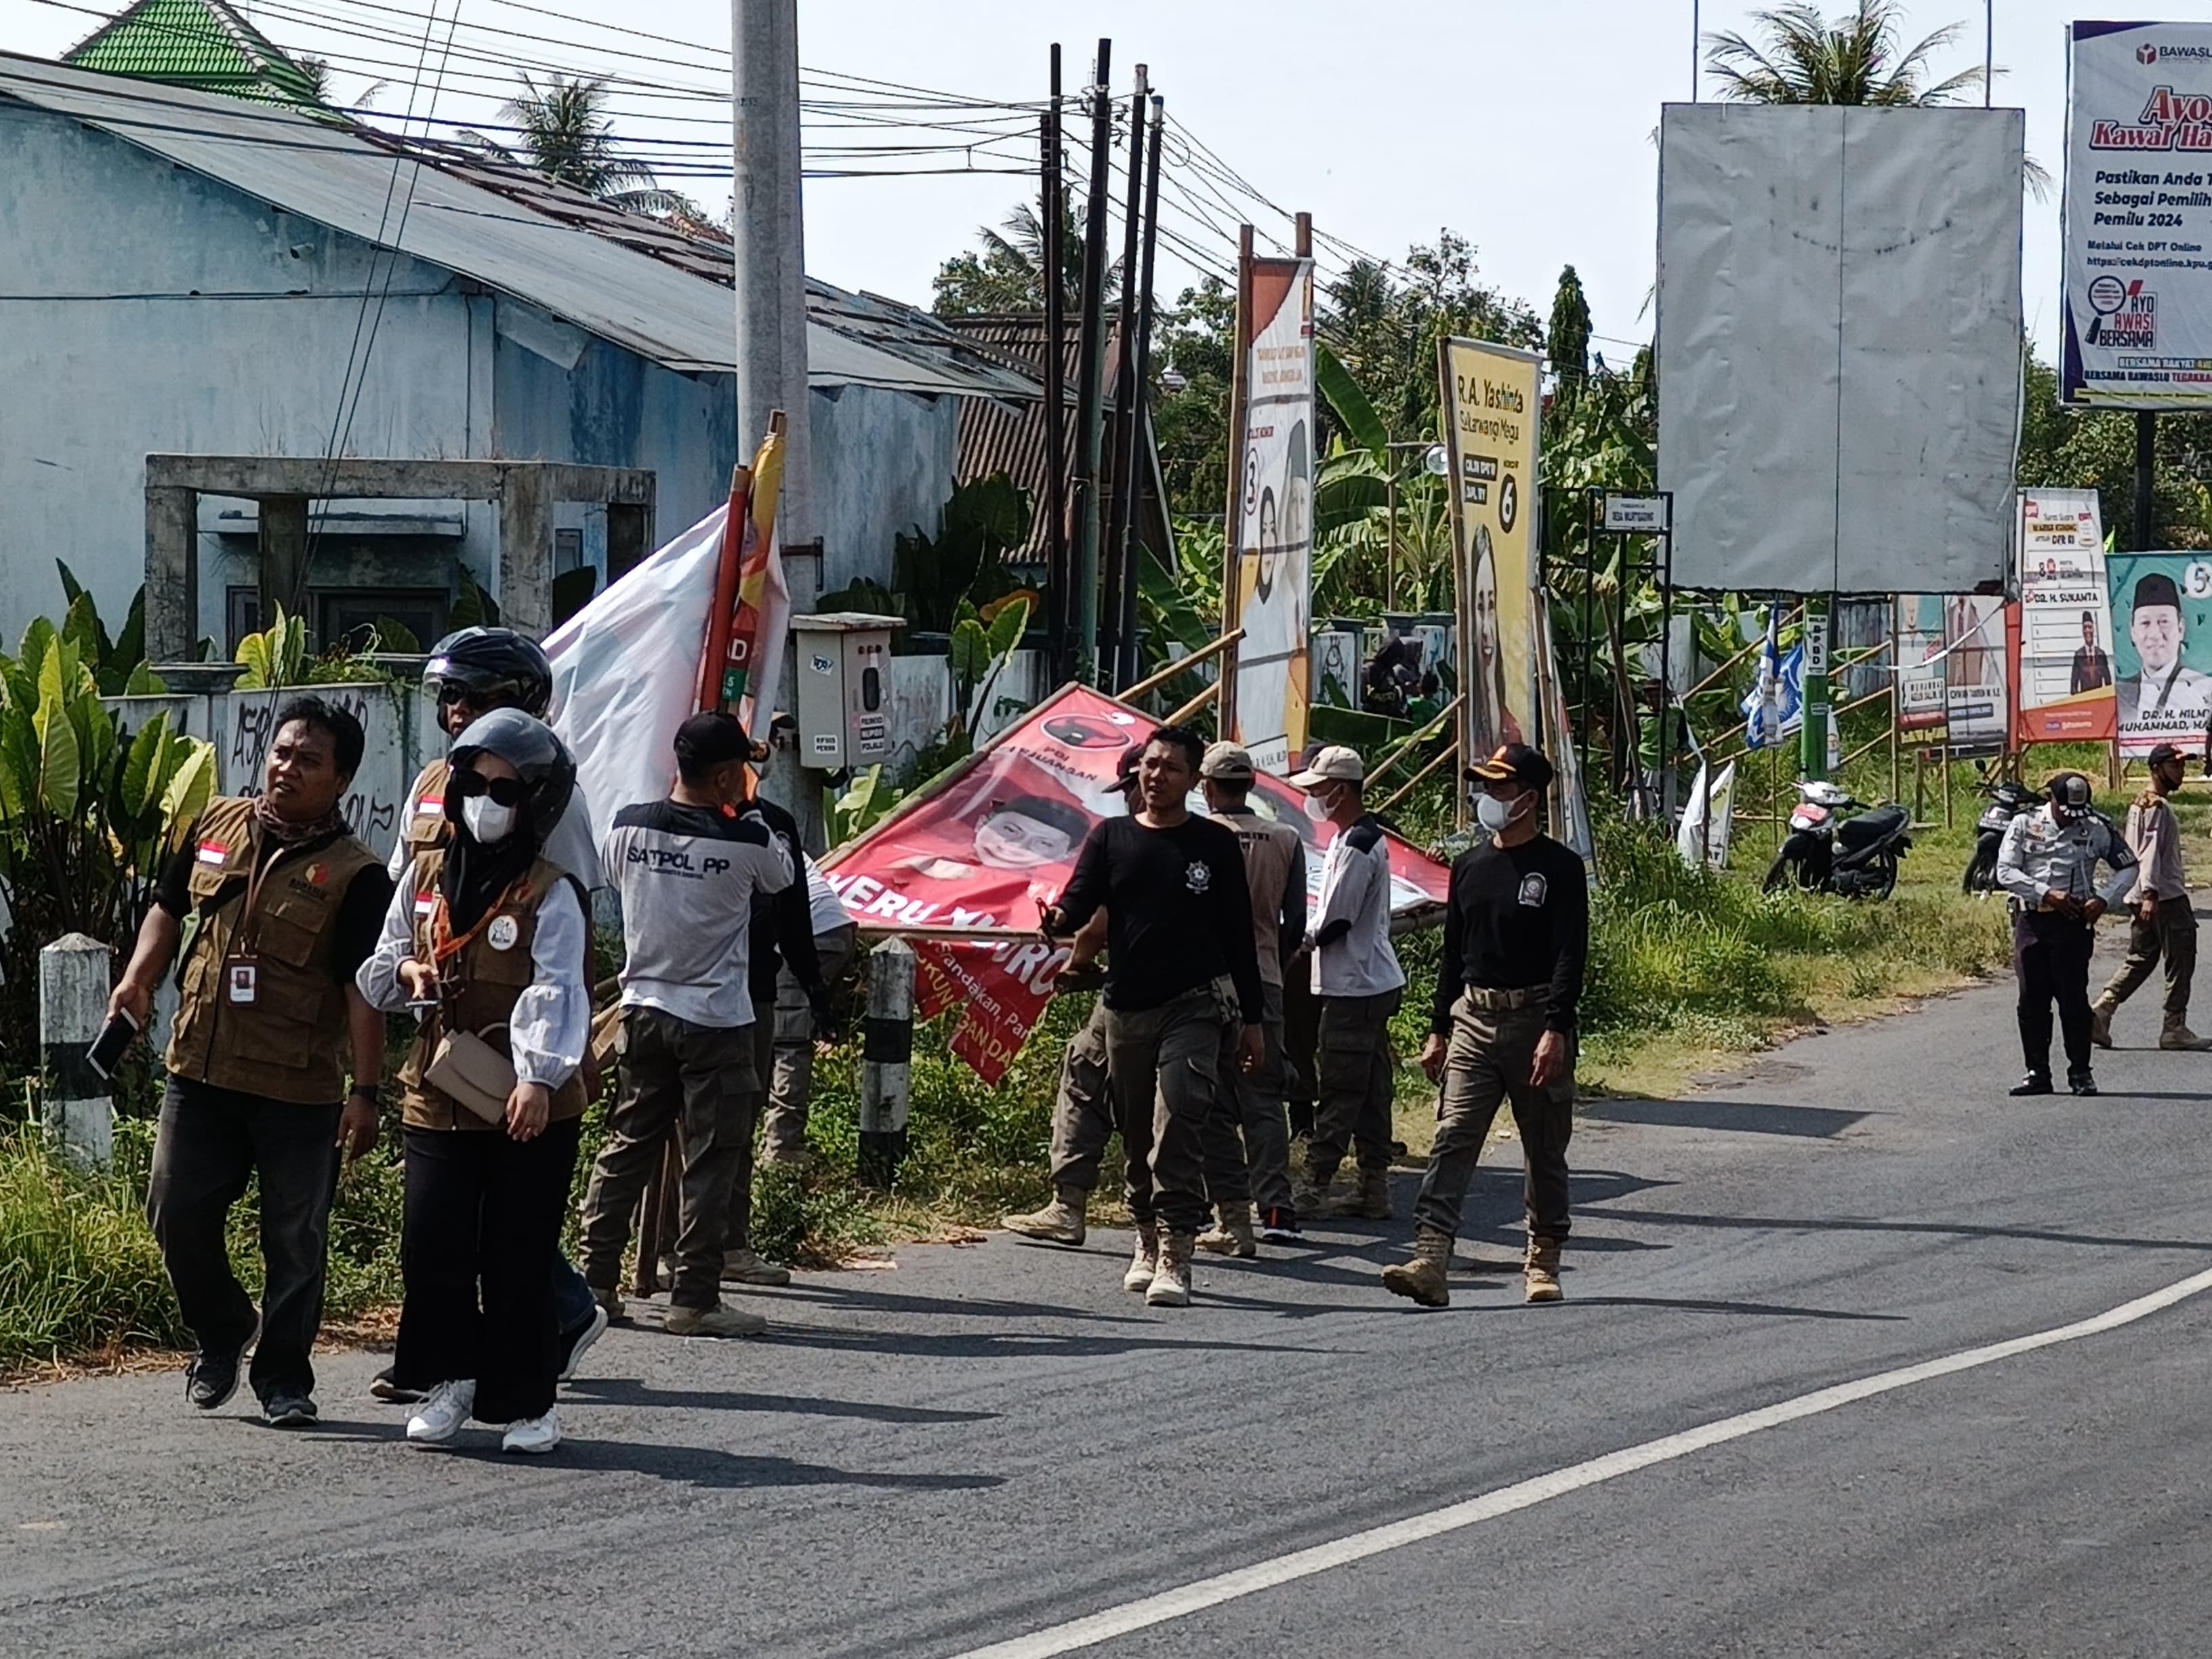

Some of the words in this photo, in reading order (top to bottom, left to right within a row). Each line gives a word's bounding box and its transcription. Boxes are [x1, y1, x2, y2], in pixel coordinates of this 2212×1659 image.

[2095, 169, 2159, 185] Pastikan
[2163, 172, 2203, 186] Anda
[2094, 190, 2155, 208] Sebagai
[2157, 192, 2212, 207] Pemilih
[2093, 211, 2144, 225] Pemilu
[2147, 213, 2183, 226] 2024
[2125, 241, 2144, 251] Cek
[2147, 242, 2167, 251] DPT
[2170, 243, 2202, 251] Online
[2131, 295, 2154, 313] AYO
[2114, 313, 2154, 330] AWASI
[2099, 330, 2154, 348] BERSAMA
[1502, 482, 1514, 525] 6
[2142, 710, 2162, 720] DR.
[2165, 710, 2175, 719] H.
[626, 847, 695, 871] SATPOL
[703, 857, 731, 875] PP
